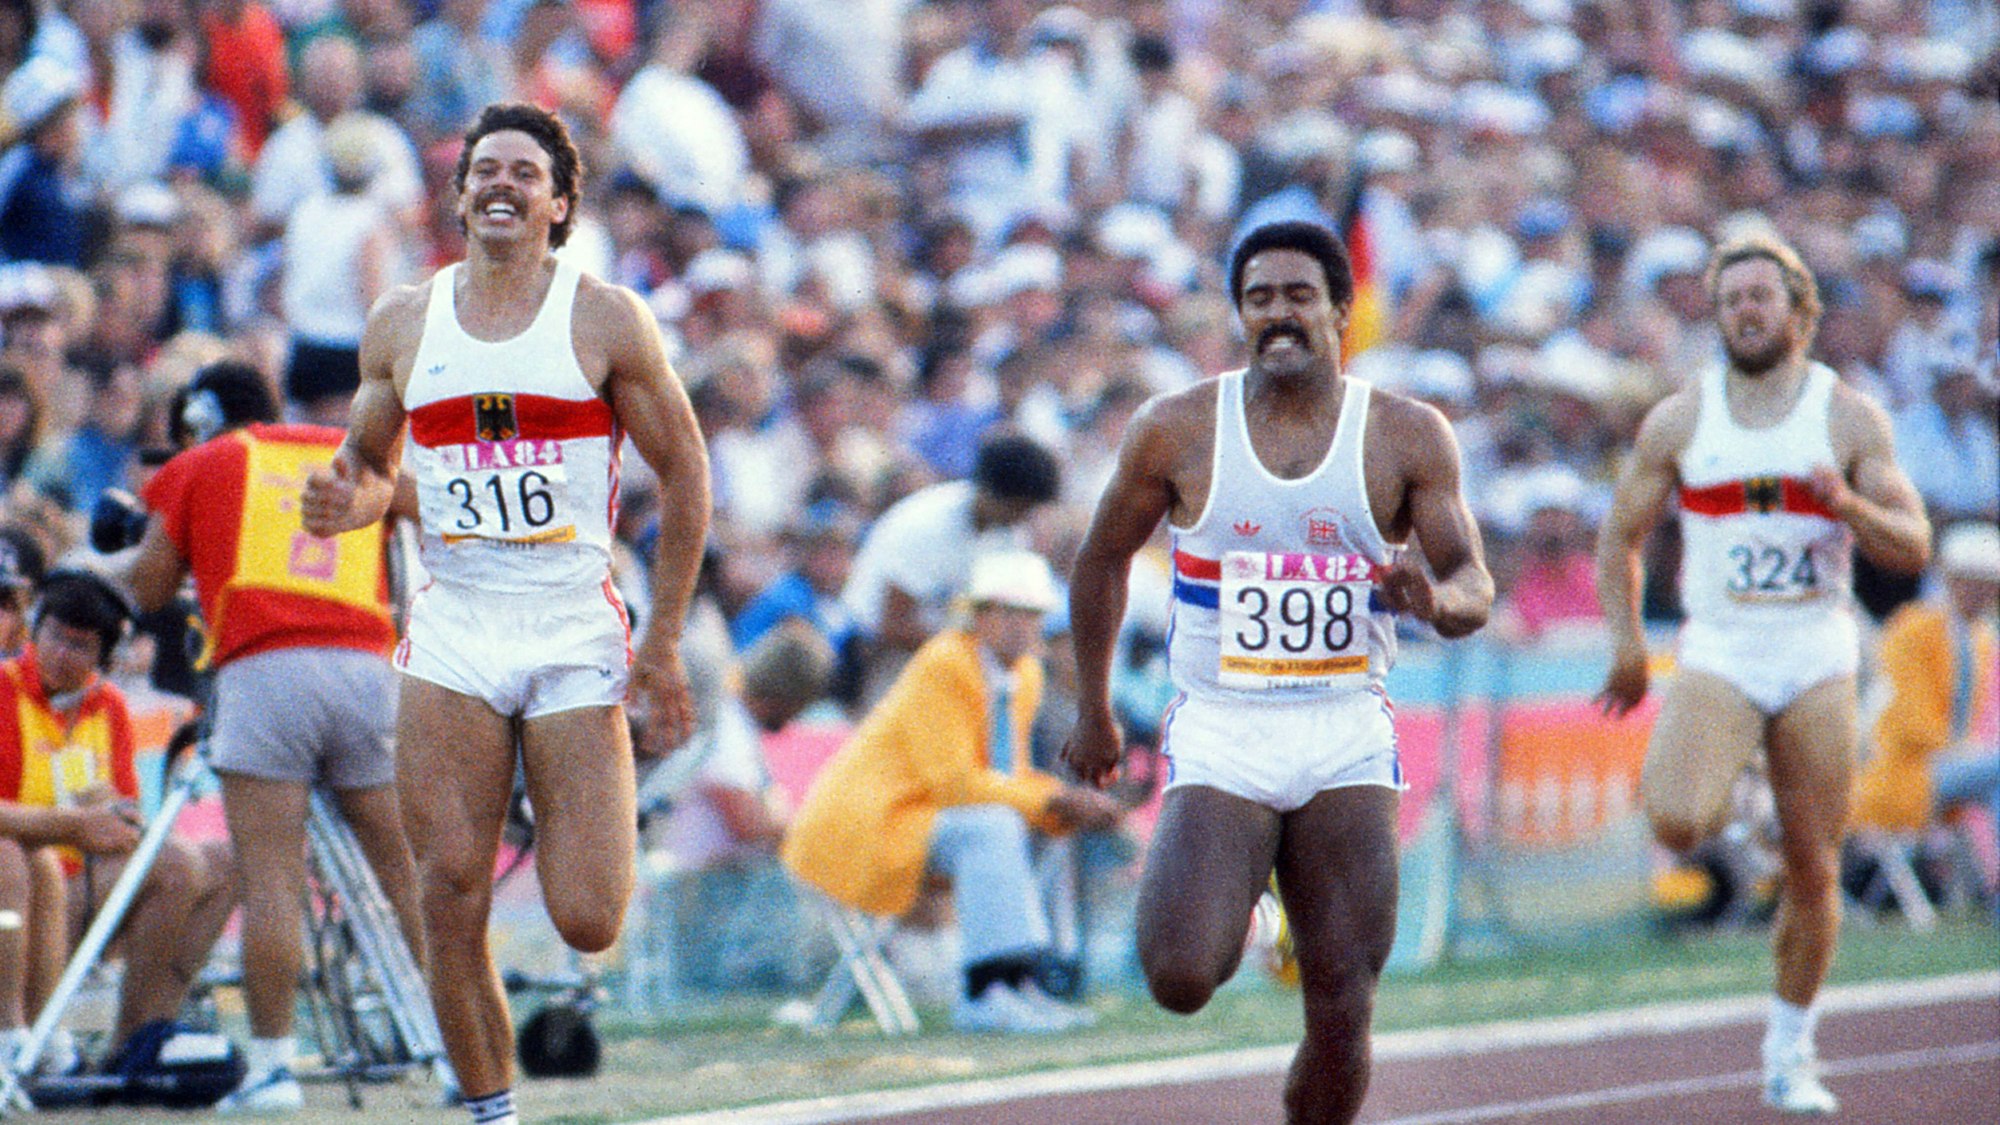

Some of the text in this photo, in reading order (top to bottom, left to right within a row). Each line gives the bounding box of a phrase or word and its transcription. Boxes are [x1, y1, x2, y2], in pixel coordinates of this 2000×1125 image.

[447, 470, 554, 532] 316
[1727, 544, 1816, 593] 324
[1236, 584, 1353, 652] 398
